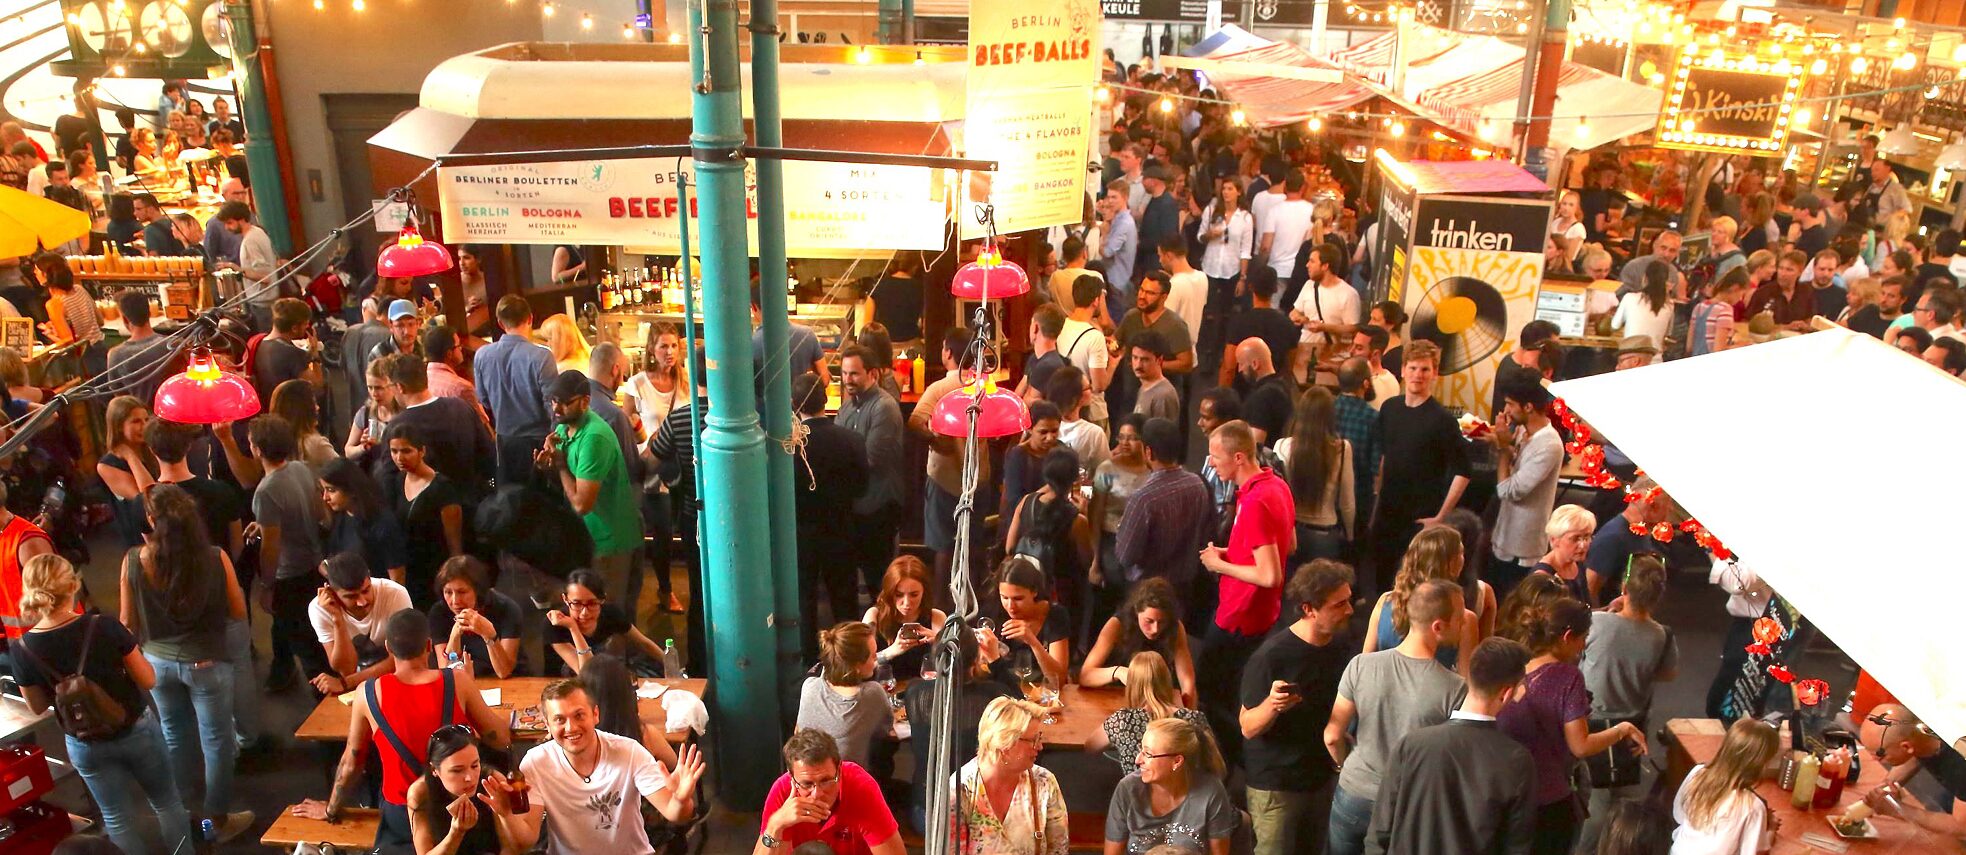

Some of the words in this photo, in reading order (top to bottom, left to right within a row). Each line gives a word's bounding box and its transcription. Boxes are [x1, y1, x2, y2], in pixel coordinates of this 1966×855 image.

[1103, 3, 1140, 15] KEULE
[1012, 16, 1061, 29] BERLIN
[1036, 127, 1081, 139] FLAVORS
[1036, 149, 1076, 160] BOLOGNA
[491, 166, 539, 174] ORIGINAL
[455, 175, 508, 185] BERLINER
[513, 177, 578, 186] BOULETTEN
[1034, 178, 1073, 190] BANGKOK
[825, 190, 831, 199] 4
[463, 207, 509, 217] BERLIN
[522, 208, 582, 219] BOLOGNA
[1430, 218, 1513, 251] trinken
[1412, 249, 1537, 302] BREAKFAST
